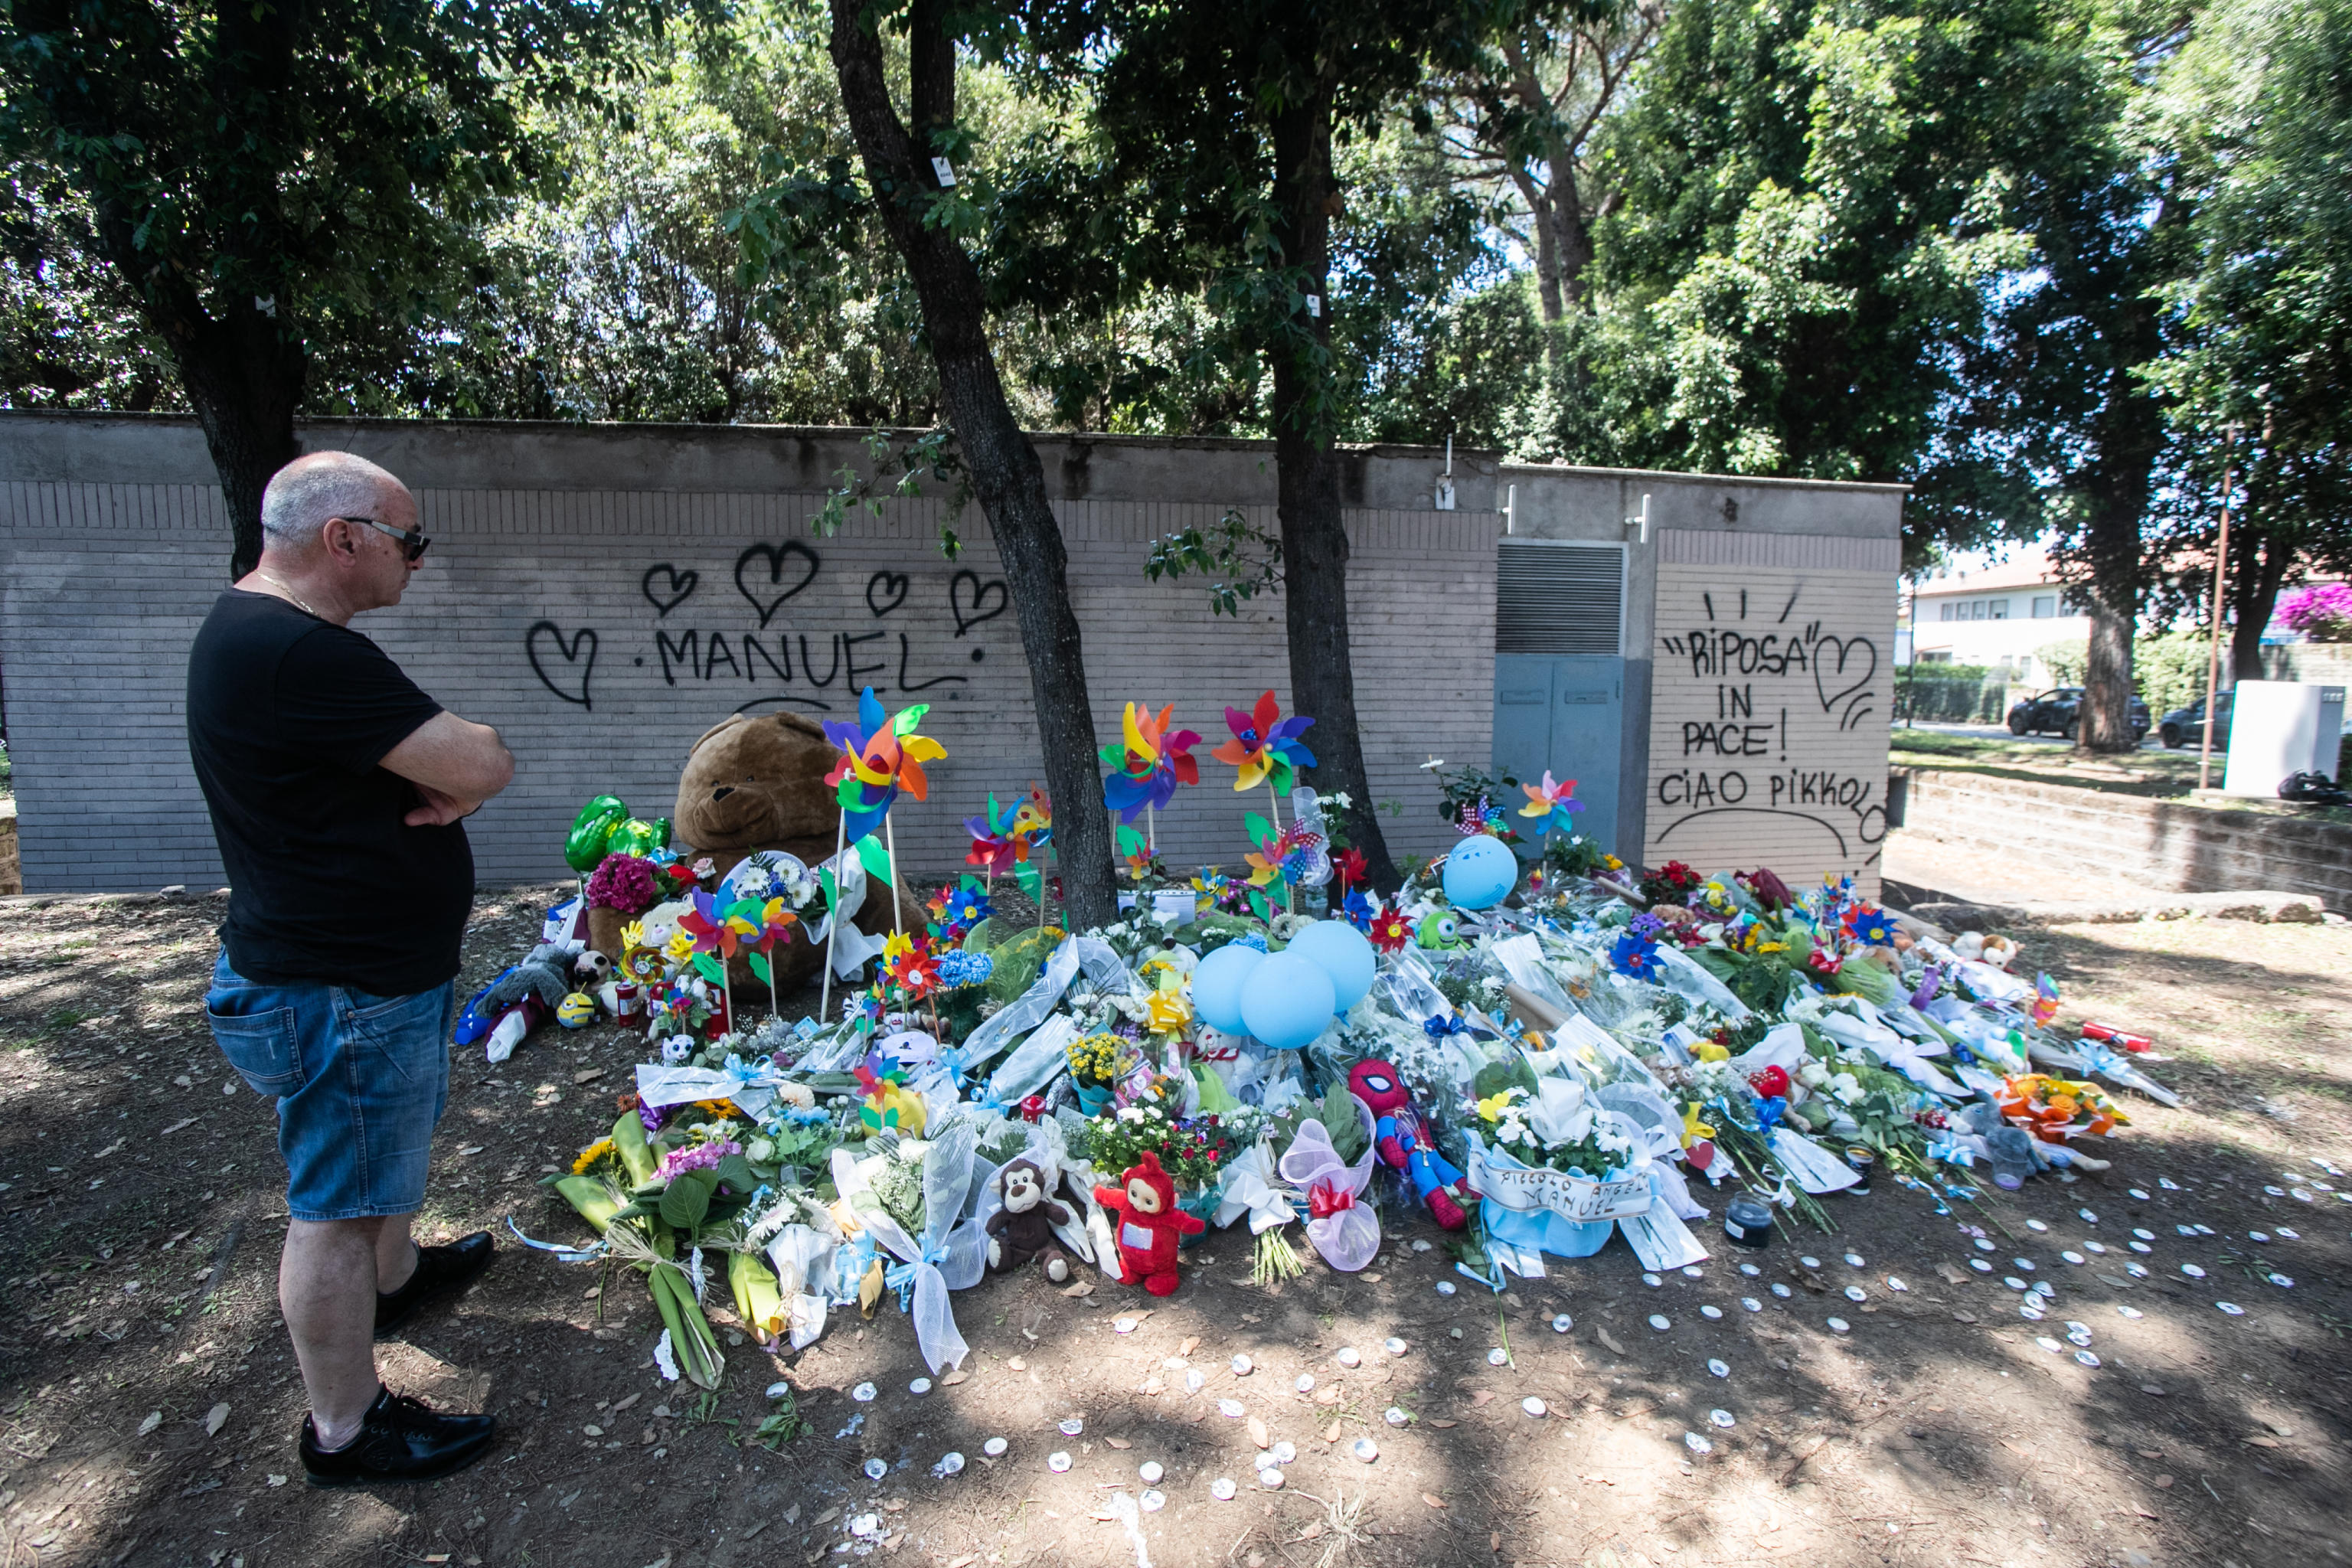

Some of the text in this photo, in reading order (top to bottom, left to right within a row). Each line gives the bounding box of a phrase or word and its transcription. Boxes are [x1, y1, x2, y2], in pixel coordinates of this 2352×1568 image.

[656, 629, 968, 696] MANUEL
[1718, 683, 1752, 720] IN
[1683, 707, 1787, 763] PACE!
[1521, 1187, 1615, 1217] MANUEL
[1590, 1181, 1648, 1200] ANGEL
